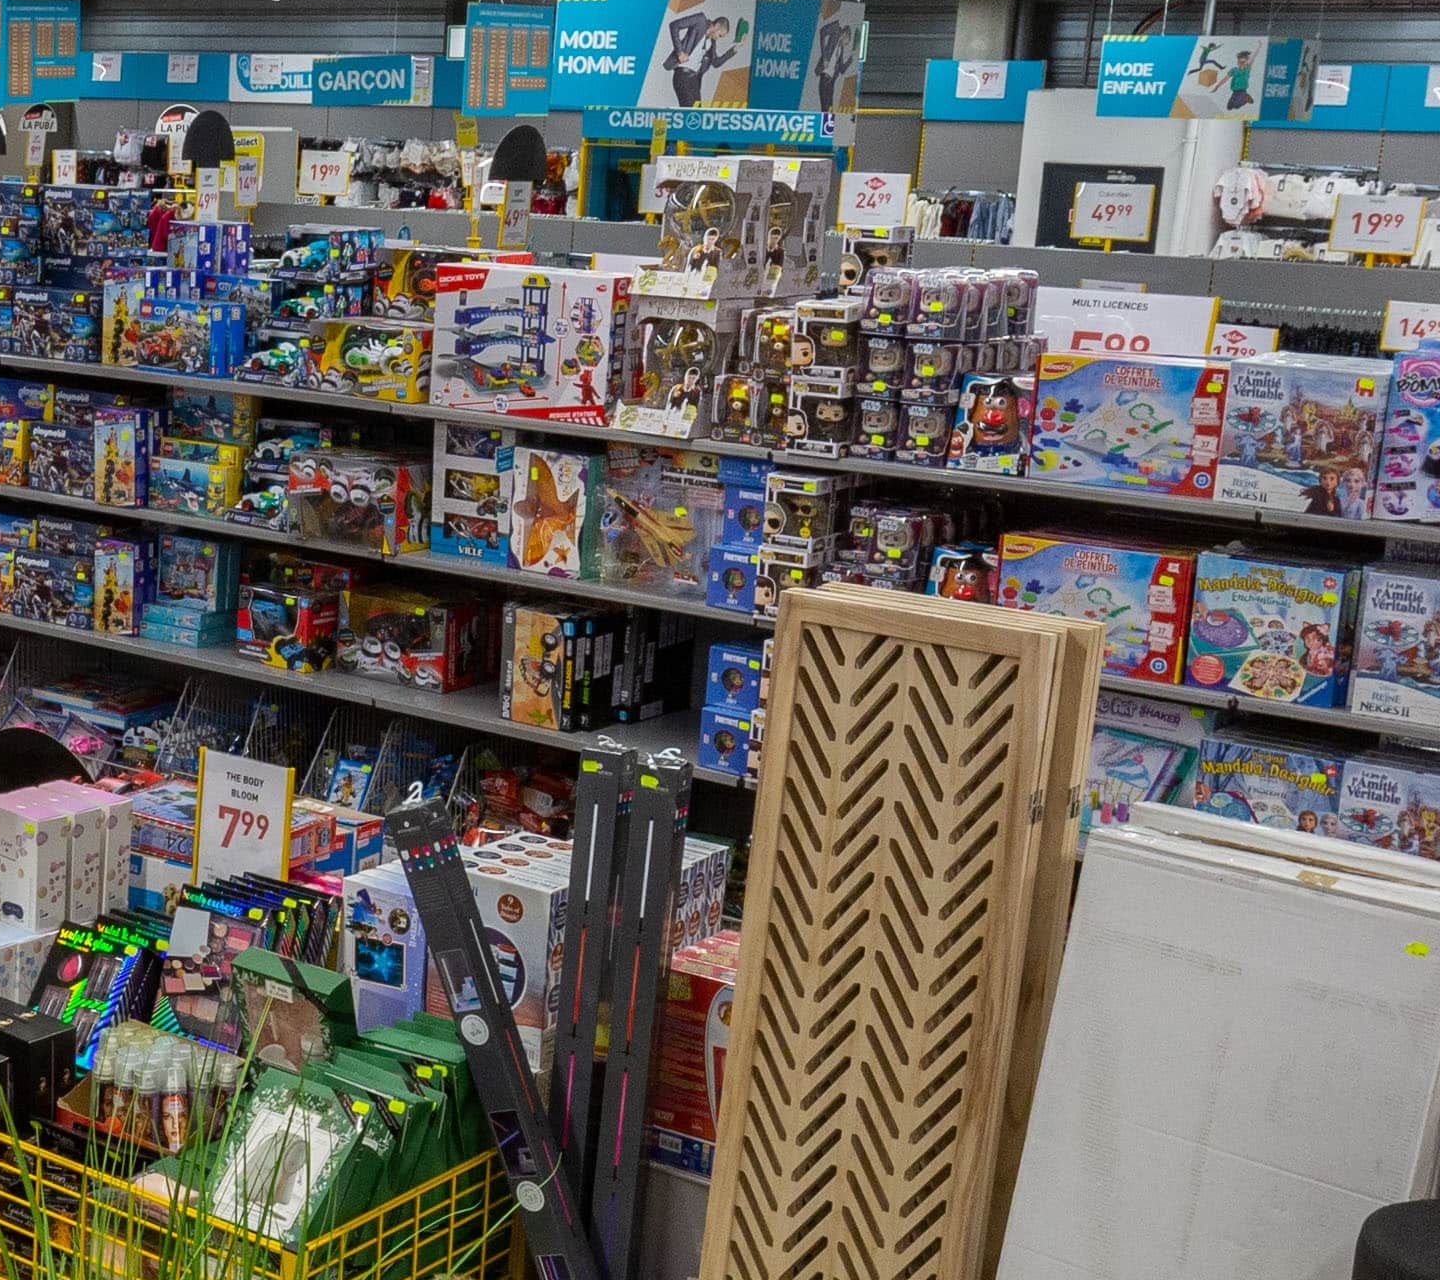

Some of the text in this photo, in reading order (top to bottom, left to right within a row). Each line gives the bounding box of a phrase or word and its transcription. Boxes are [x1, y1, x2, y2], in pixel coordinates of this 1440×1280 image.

[559, 29, 618, 50] MODE
[757, 31, 792, 52] MODE
[558, 54, 636, 76] HOMME
[755, 58, 800, 80] HOMME
[1105, 63, 1154, 78] MODE
[317, 70, 406, 94] GARÇON
[1103, 81, 1166, 96] ENFANT
[608, 110, 816, 134] CABINES D'ESSAYAGE
[310, 163, 341, 182] 1999
[855, 192, 892, 211] 2499
[1091, 203, 1133, 222] 4999
[1351, 209, 1405, 236] 1999
[1072, 297, 1150, 312] MULTI LICENCES
[1114, 364, 1154, 379] COFFRET
[1232, 384, 1285, 401] Véritable
[1370, 598, 1427, 616] Véritable
[226, 770, 264, 788] THE BODY
[230, 789, 259, 802] BLOOM
[1346, 787, 1402, 806] Véritable
[217, 804, 270, 849] 799
